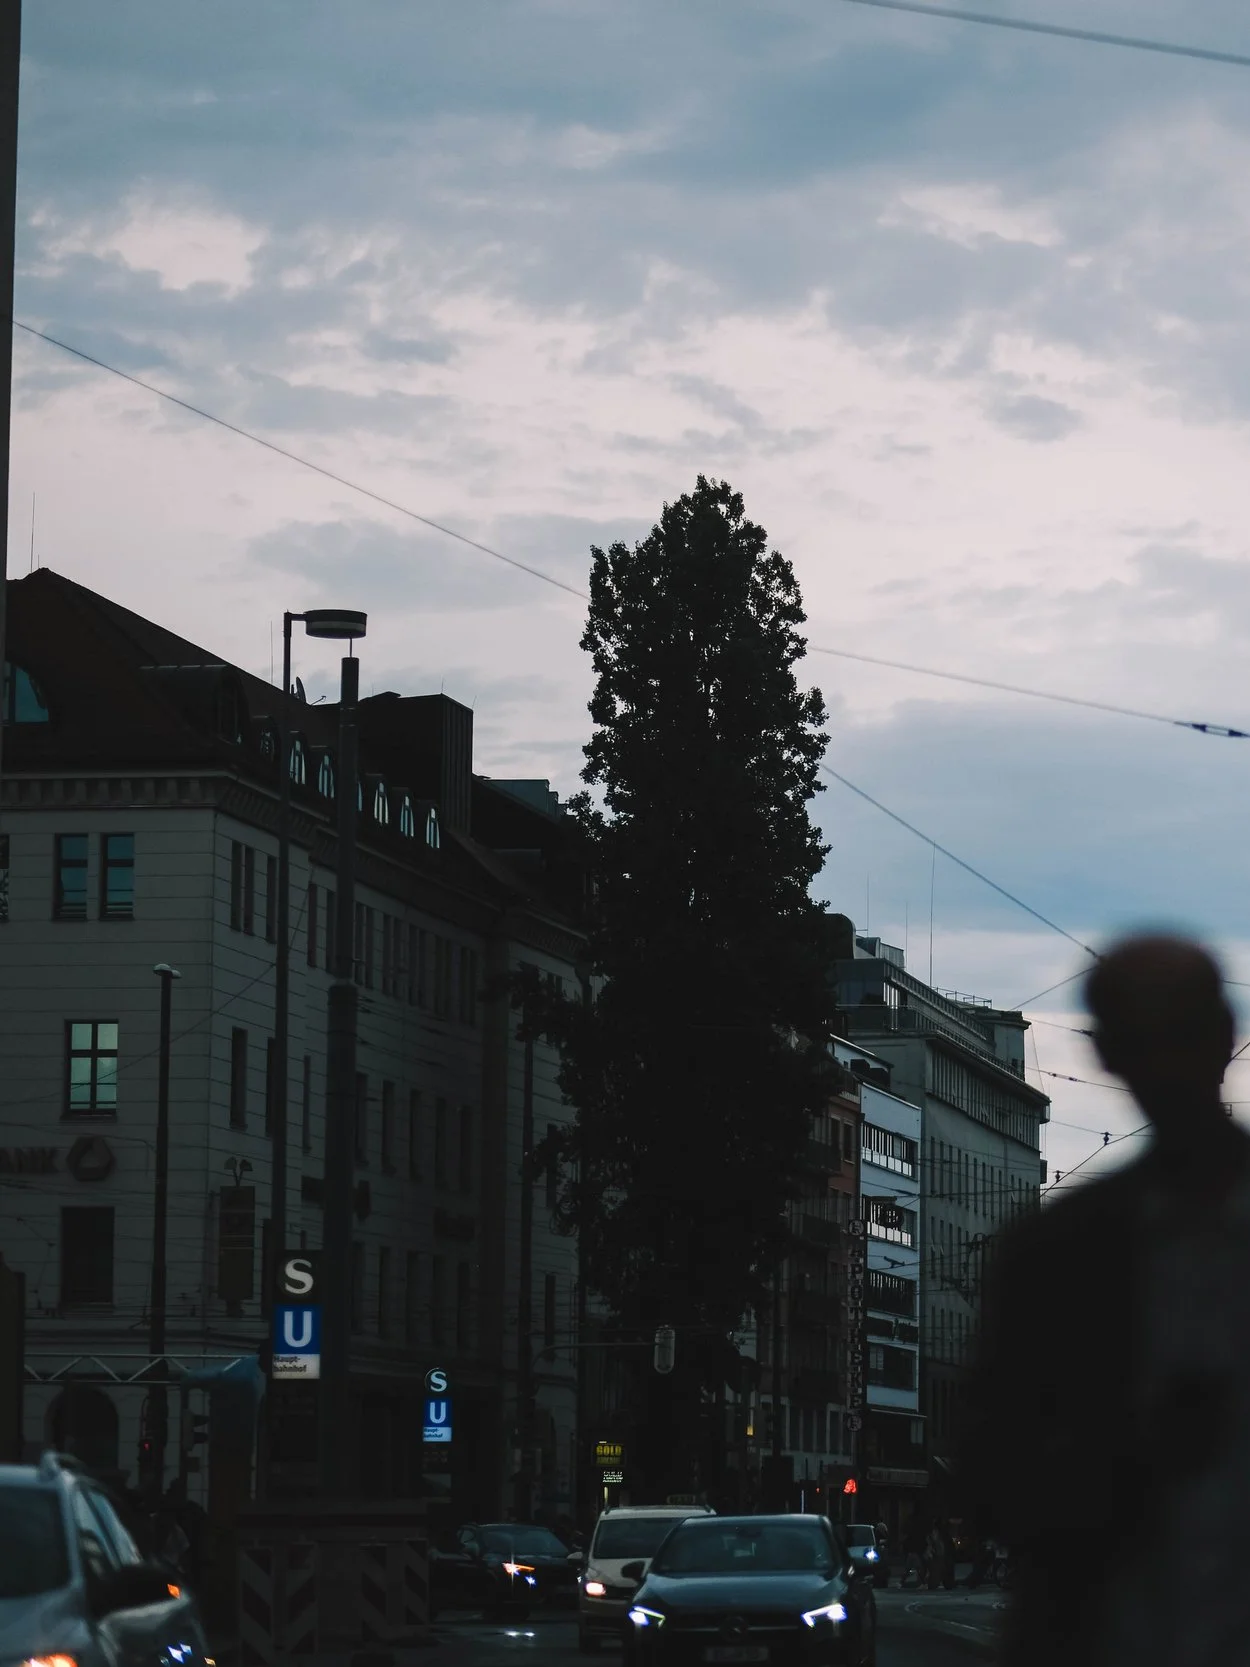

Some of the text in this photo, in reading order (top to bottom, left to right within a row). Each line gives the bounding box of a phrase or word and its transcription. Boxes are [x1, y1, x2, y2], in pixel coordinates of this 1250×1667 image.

[285, 1258, 314, 1294] S
[284, 1311, 312, 1348] U
[273, 1364, 307, 1373] bahnhof
[274, 1355, 300, 1364] Haupt-
[430, 1371, 448, 1392] S
[429, 1402, 446, 1424] U
[596, 1445, 622, 1456] GOLD
